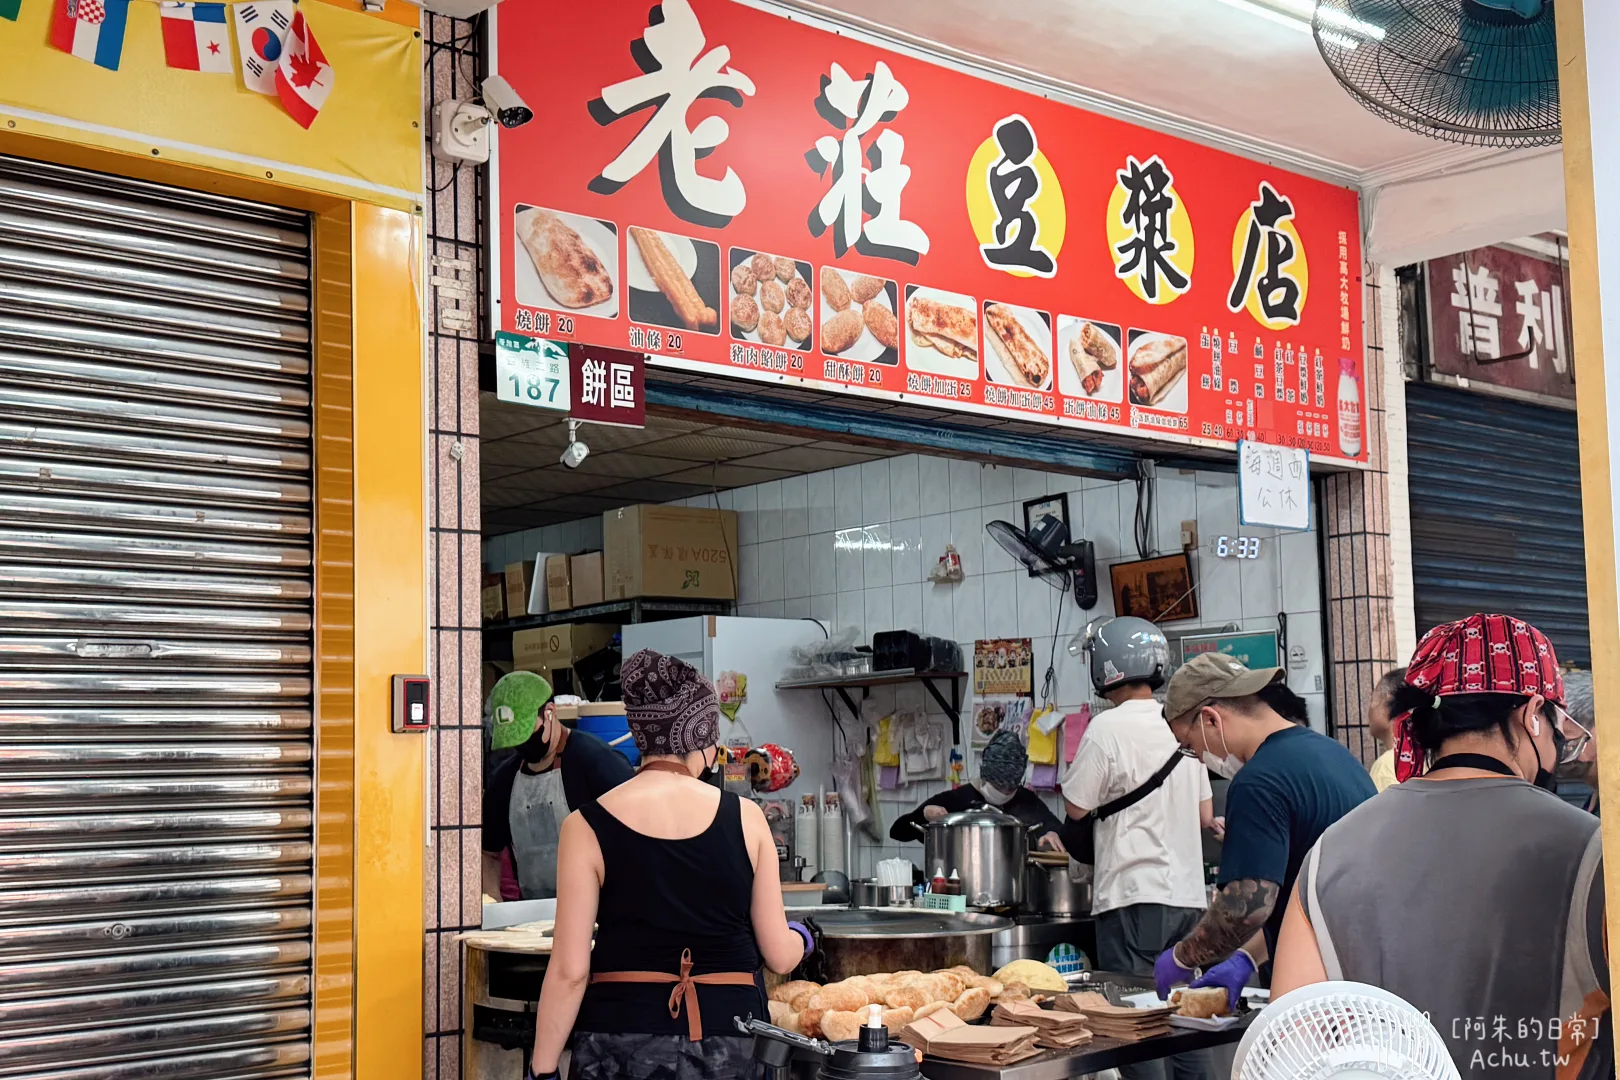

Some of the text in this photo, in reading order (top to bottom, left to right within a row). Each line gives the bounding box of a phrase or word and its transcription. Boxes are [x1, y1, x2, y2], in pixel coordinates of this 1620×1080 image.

[587, 0, 1301, 327] 老莊豆漿店
[516, 309, 574, 334] 燒餅 20
[629, 328, 682, 349] 油條 20
[730, 343, 803, 371] 豬肉餡餅 20
[581, 358, 635, 408] 餅區
[824, 360, 881, 383] 甜酥餅 20
[508, 373, 560, 403] 187
[907, 373, 971, 398] 燒餅加蛋 25
[984, 386, 1054, 411] 燒餅加蛋餅 45
[1064, 399, 1120, 420] 蛋餅油條 45
[1179, 417, 1188, 428] 65
[1202, 423, 1211, 435] 25
[1213, 425, 1223, 437] 40
[1258, 486, 1298, 511] 公休
[1217, 536, 1260, 559] 6:33
